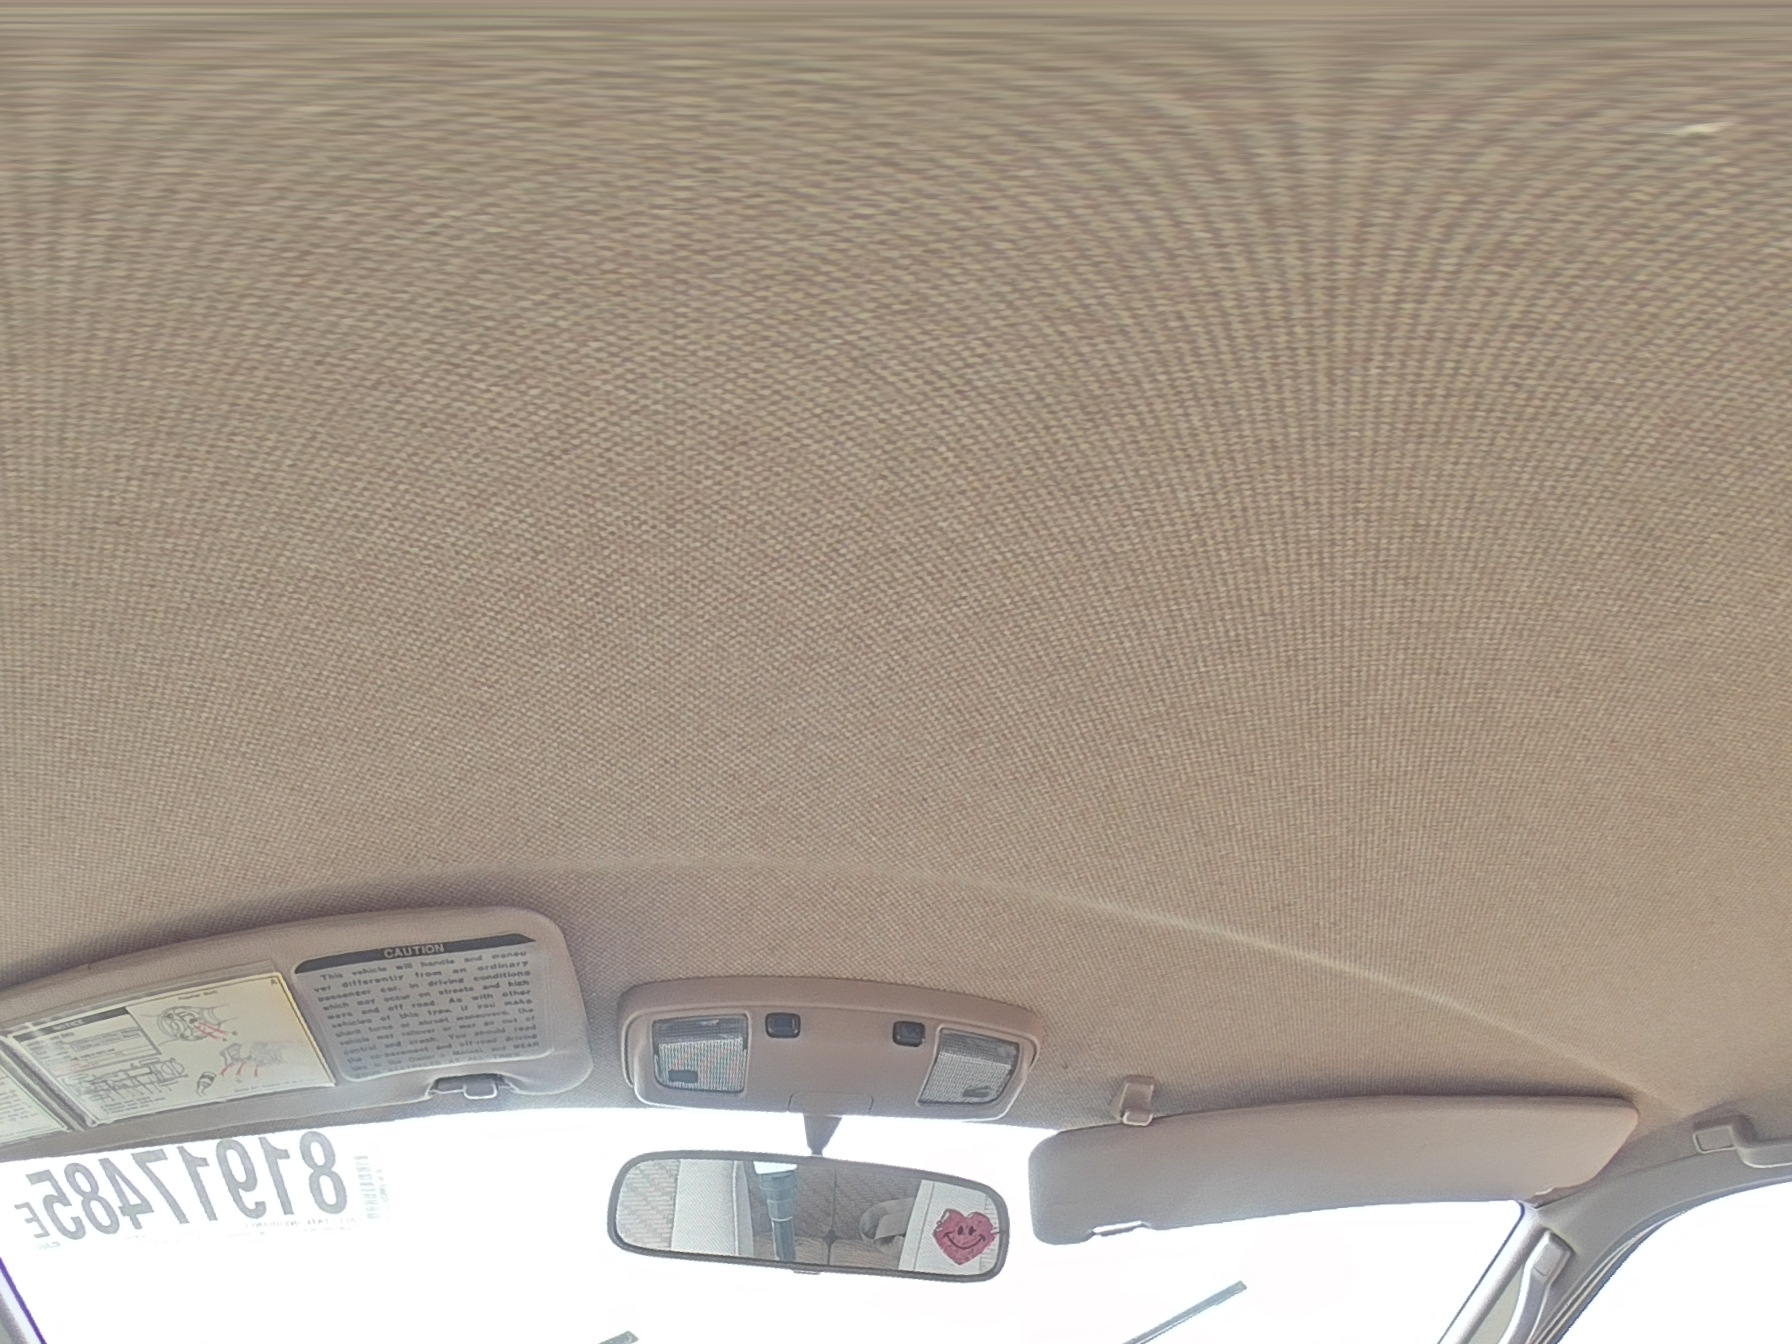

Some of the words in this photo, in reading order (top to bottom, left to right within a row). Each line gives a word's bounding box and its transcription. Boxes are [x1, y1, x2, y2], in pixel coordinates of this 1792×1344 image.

[383, 943, 445, 959] CAUTION
[320, 972, 344, 982] This
[351, 966, 388, 977] vehicle
[395, 962, 413, 971] will
[420, 959, 456, 968] handle
[464, 955, 484, 963] and
[341, 974, 404, 989] differently
[414, 970, 443, 979] from
[477, 960, 529, 973] ordinary
[317, 988, 372, 1003] passenger
[427, 976, 465, 988] driving
[473, 969, 531, 982] conditions
[322, 1002, 350, 1012] which
[438, 985, 475, 996] streets
[482, 981, 501, 991] and
